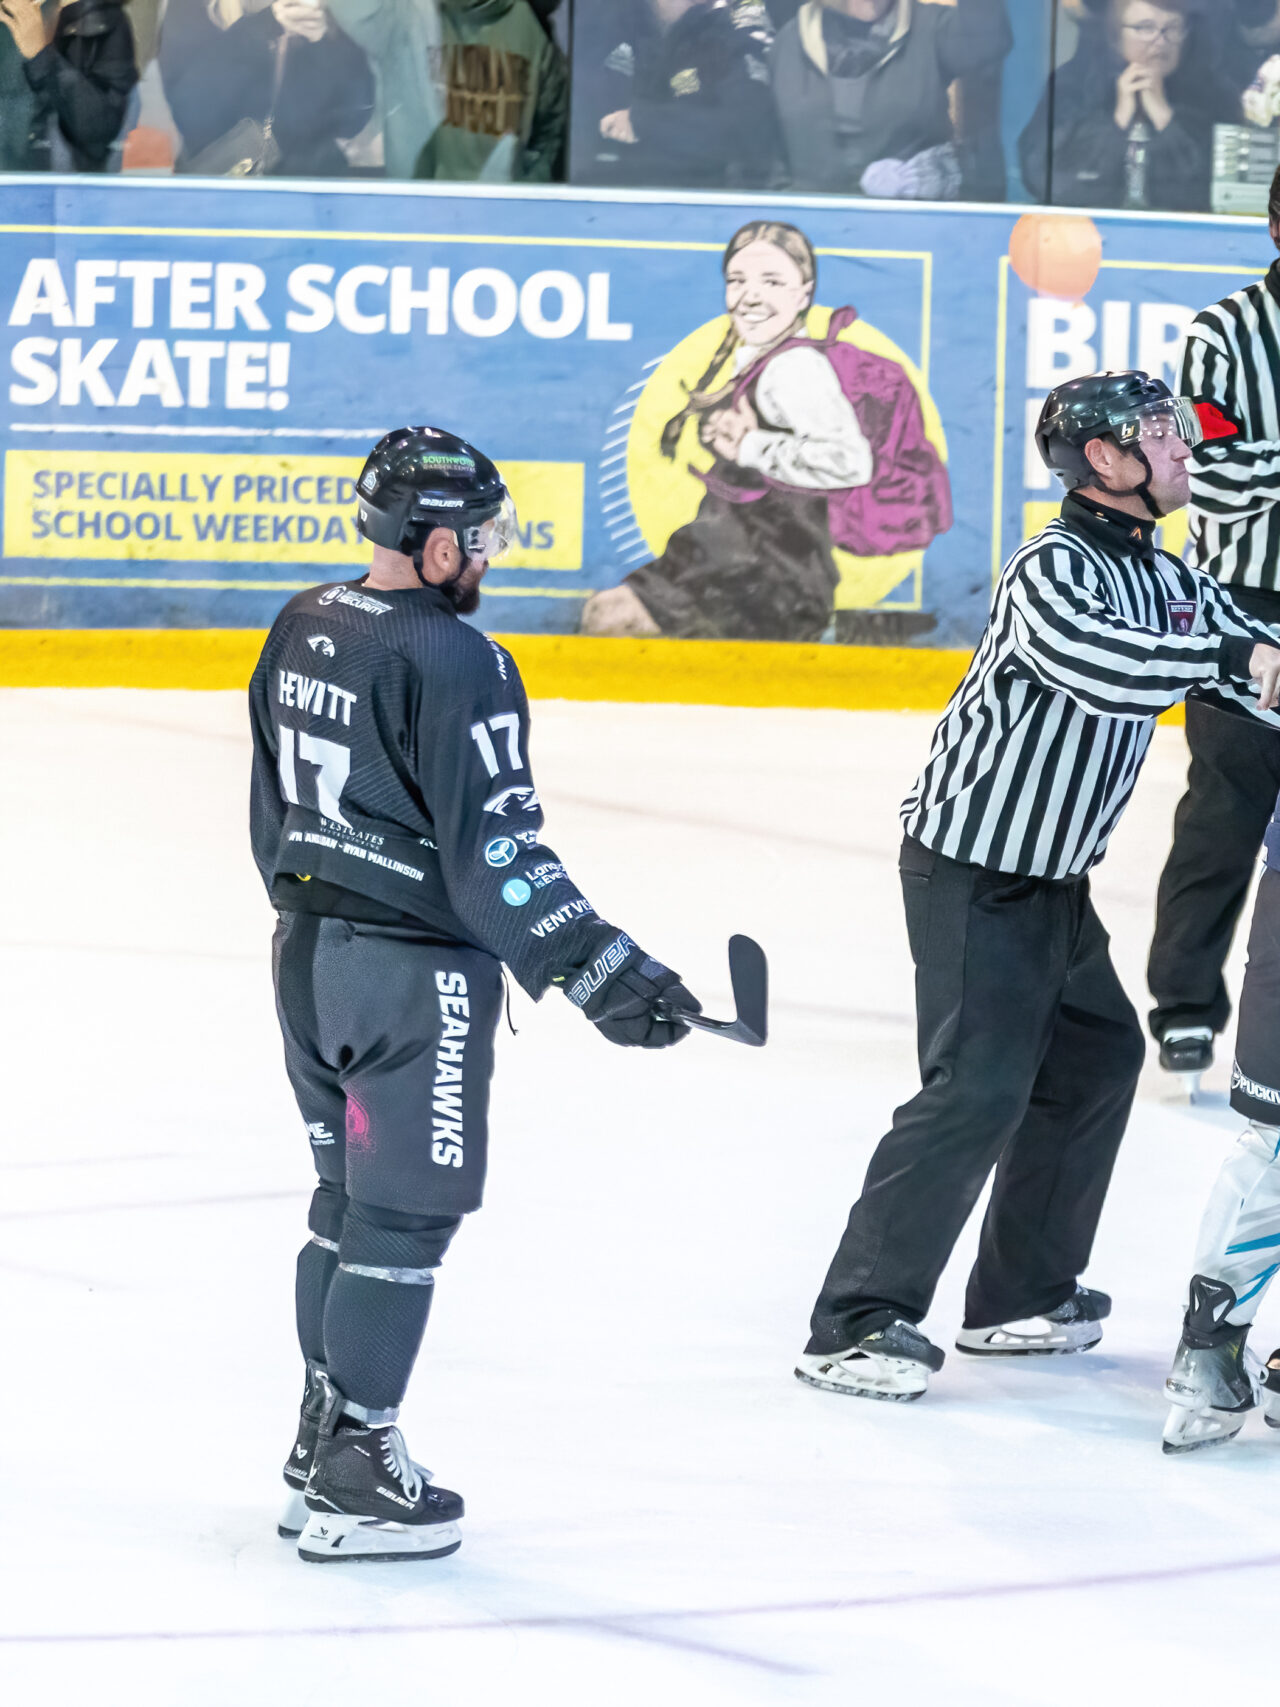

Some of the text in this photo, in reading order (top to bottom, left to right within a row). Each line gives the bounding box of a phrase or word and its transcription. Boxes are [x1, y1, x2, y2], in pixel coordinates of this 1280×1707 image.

[7, 258, 633, 341] AFTER SCHOOL
[9, 337, 290, 411] SKATE!
[32, 469, 358, 507] SPECIALLY PRICED
[420, 498, 465, 509] BAUER
[32, 509, 182, 543] SCHOOL
[338, 596, 387, 616] SECURITY
[279, 669, 358, 727] HEWITT
[471, 711, 524, 778] 17
[279, 724, 353, 832] 17
[368, 851, 425, 882] MALLINSON
[432, 970, 471, 1168] SEAHAWKS
